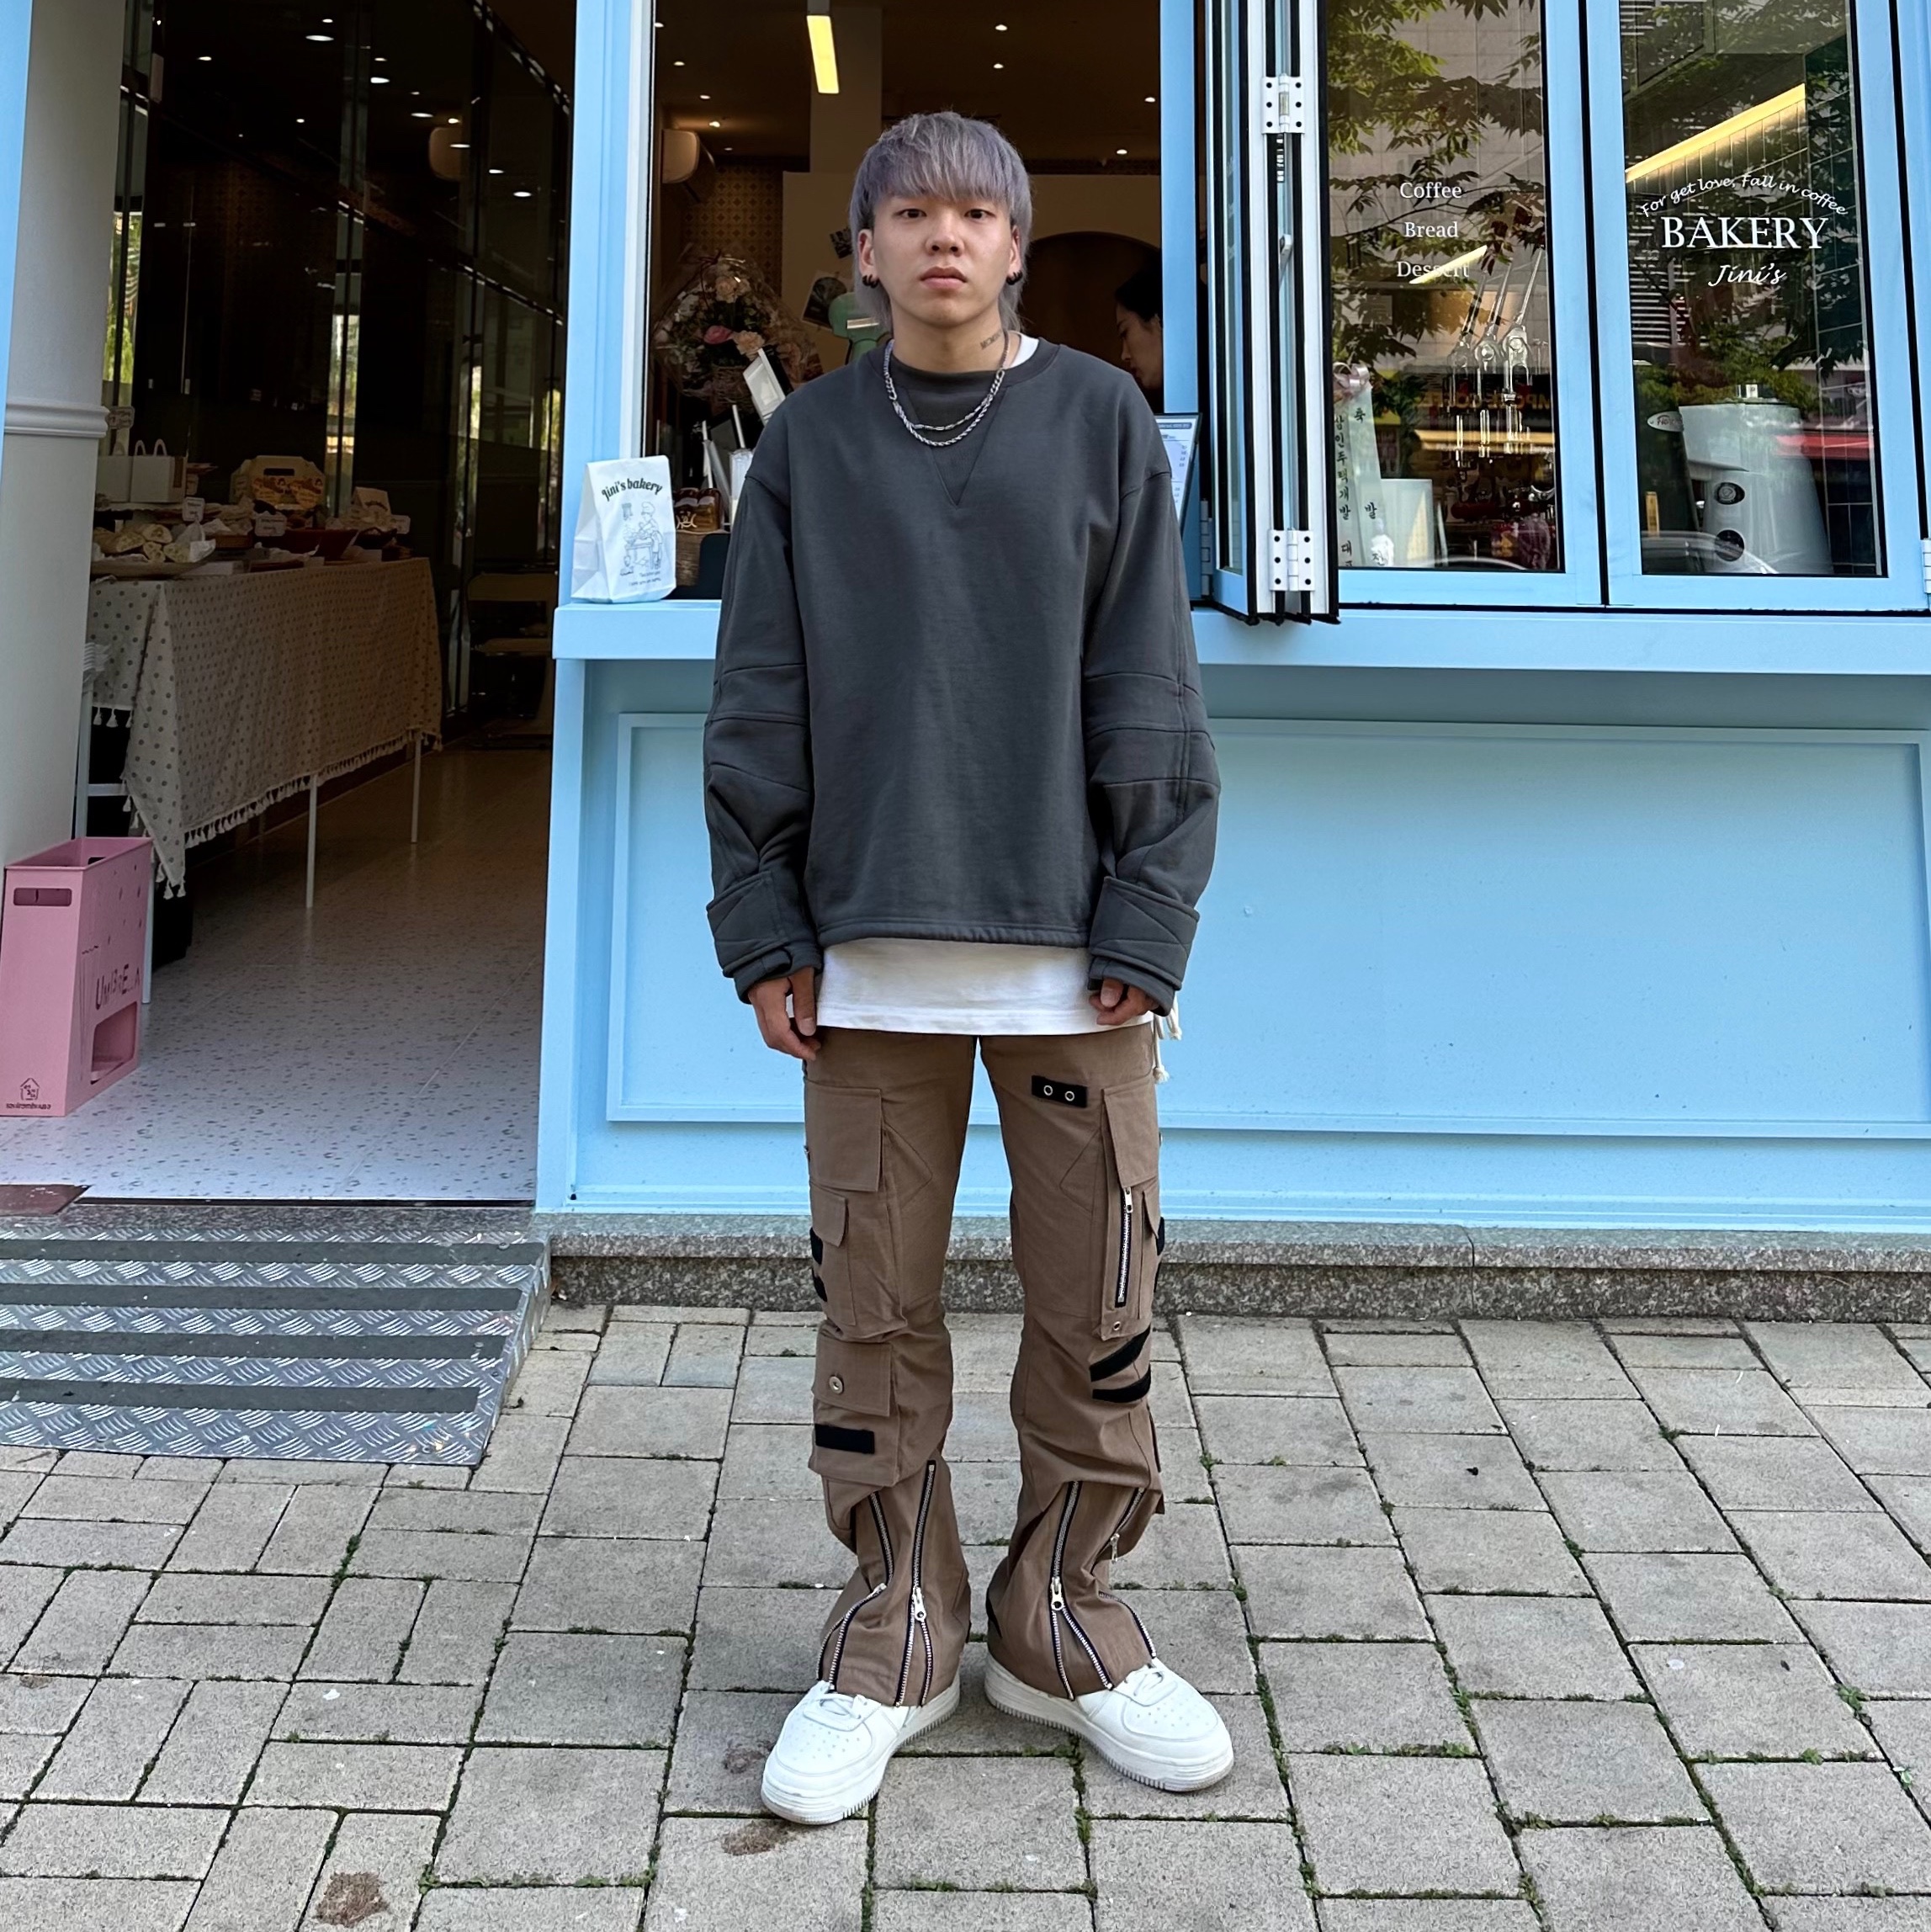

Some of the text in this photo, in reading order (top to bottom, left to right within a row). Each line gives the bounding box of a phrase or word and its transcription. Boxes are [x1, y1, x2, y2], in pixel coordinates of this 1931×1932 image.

[1399, 182, 1462, 199] Coffee
[1641, 173, 1849, 217] For get love, Fall in coffee
[1403, 221, 1459, 238] Bread
[1660, 216, 1829, 249] BAKERY
[1707, 263, 1787, 287] Jini's
[1353, 407, 1366, 424] 축
[626, 477, 663, 496] bakery
